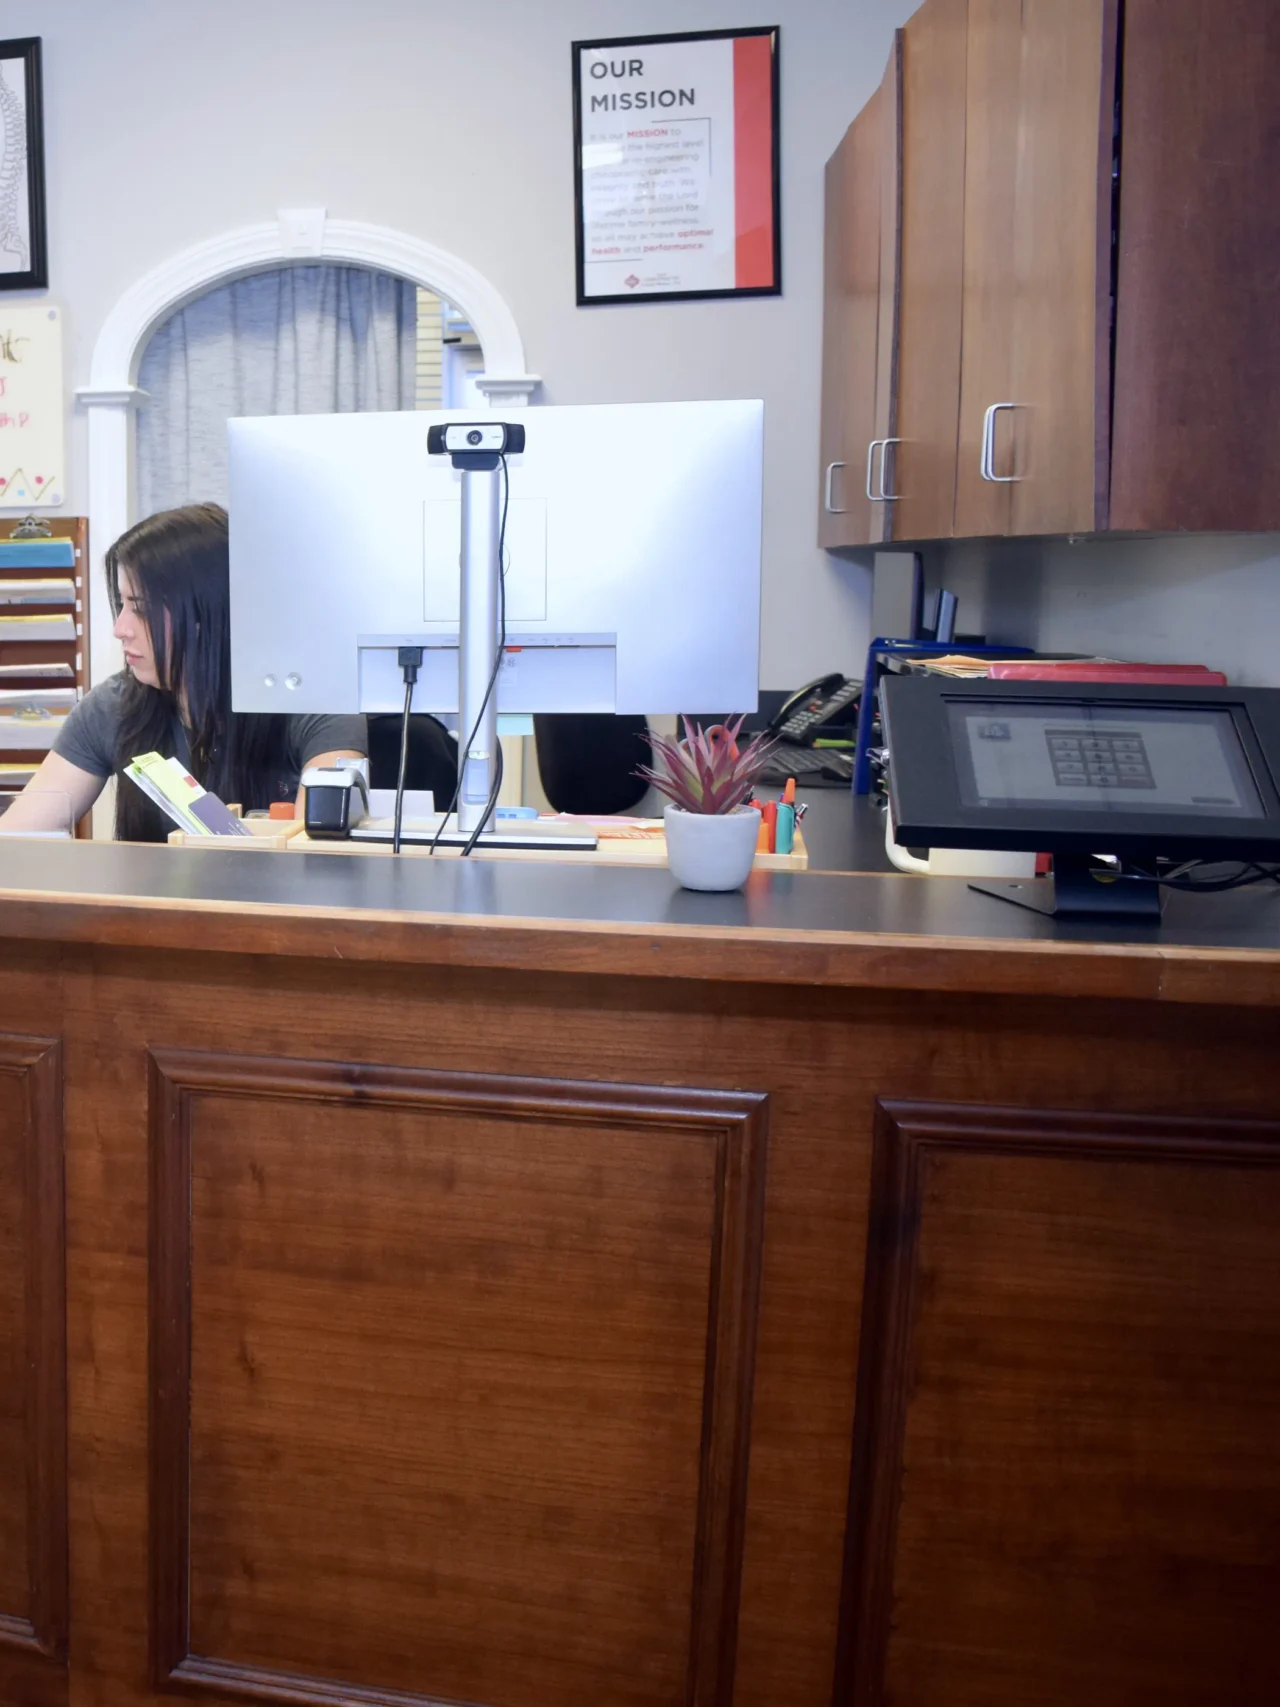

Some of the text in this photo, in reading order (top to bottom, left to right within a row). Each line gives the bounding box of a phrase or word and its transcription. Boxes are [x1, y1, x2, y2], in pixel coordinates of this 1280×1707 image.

[590, 59, 643, 79] OUR
[591, 88, 695, 112] MISSION
[627, 128, 668, 138] MISSION
